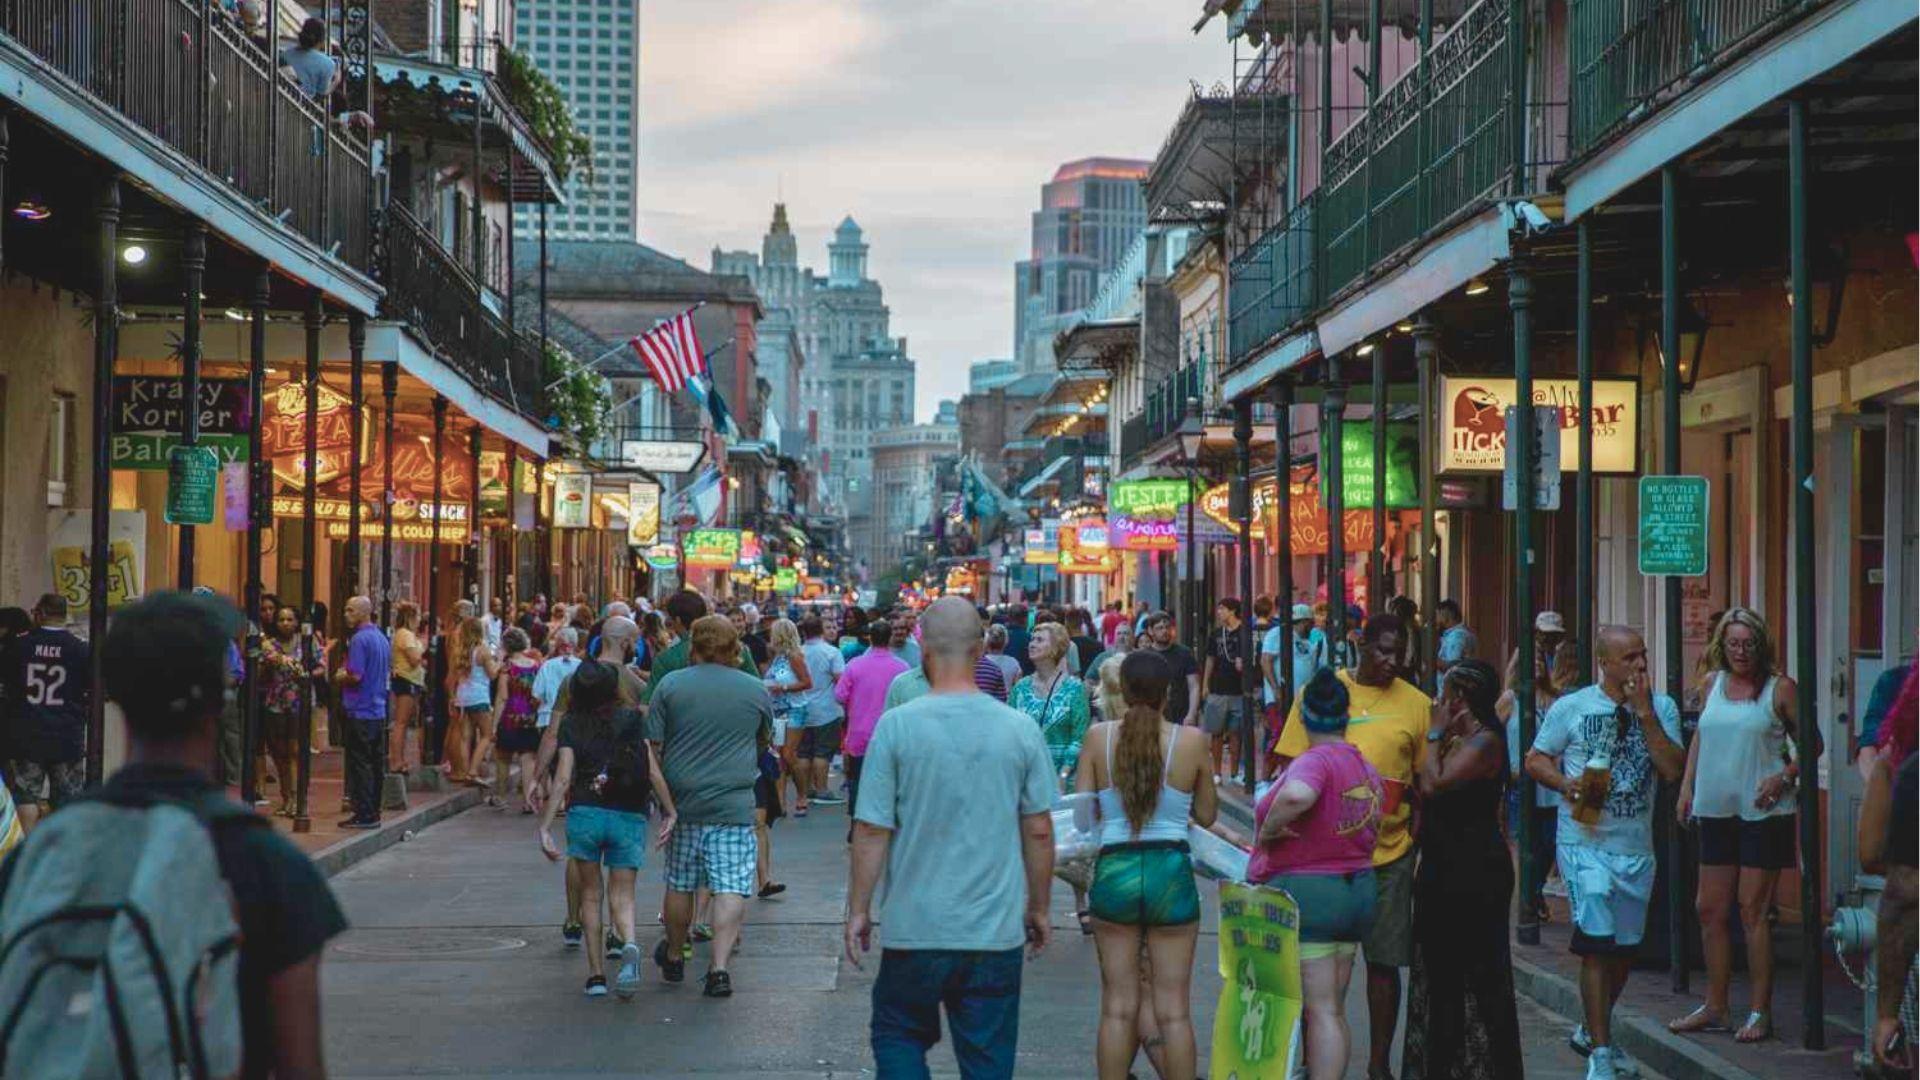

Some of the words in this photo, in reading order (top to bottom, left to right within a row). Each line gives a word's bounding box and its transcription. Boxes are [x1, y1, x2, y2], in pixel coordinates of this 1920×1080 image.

[130, 378, 223, 406] Kray
[122, 402, 232, 428] Korer
[111, 436, 240, 463] Baly
[61, 565, 91, 607] 3
[35, 644, 62, 658] MACK
[26, 662, 66, 706] 52
